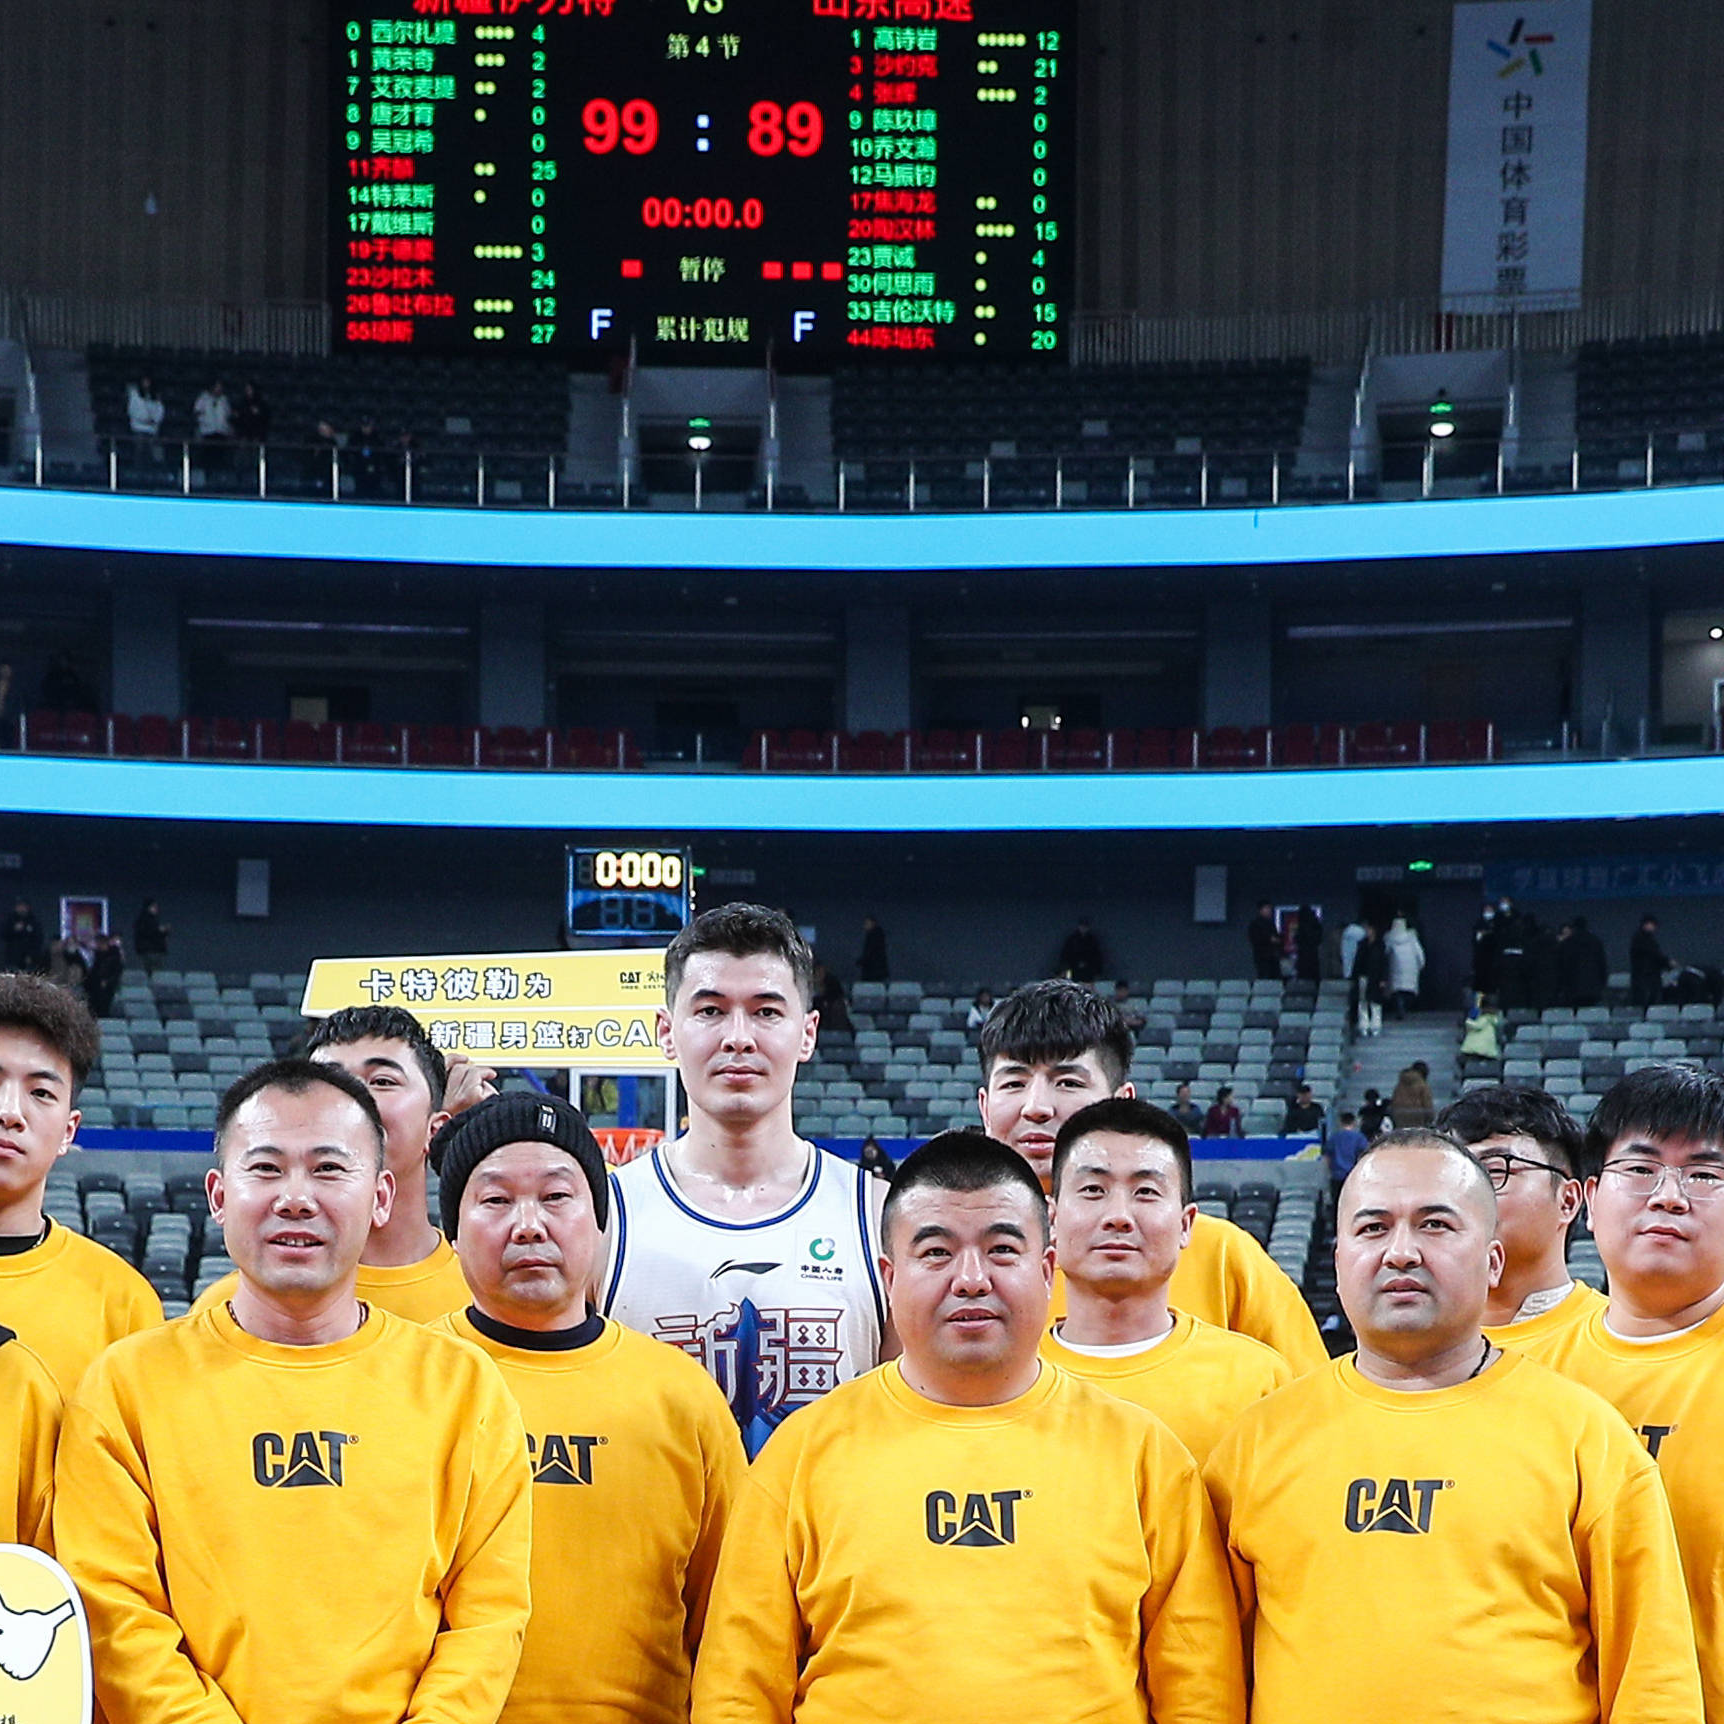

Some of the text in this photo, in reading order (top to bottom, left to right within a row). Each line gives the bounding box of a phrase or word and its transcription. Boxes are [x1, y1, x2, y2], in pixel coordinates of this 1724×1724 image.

[347, 21, 360, 41] 0
[532, 24, 545, 43] 4
[852, 29, 861, 48] 1
[1037, 31, 1059, 50] 12
[349, 50, 358, 68] 1
[532, 51, 545, 71] 2
[1035, 58, 1056, 77] 21
[347, 76, 360, 95] 7
[532, 79, 545, 98] 2
[1034, 86, 1047, 105] 2
[532, 106, 545, 125] 0
[849, 110, 862, 130] 9
[1034, 113, 1047, 132] 0
[581, 98, 659, 154] 99
[747, 100, 824, 157] 89
[346, 131, 360, 150] 9
[532, 133, 545, 152] 0
[851, 138, 873, 157] 10
[1033, 140, 1047, 159] 0
[349, 159, 370, 177] 11
[532, 161, 557, 180] 25
[850, 165, 873, 184] 12
[1033, 168, 1046, 186] 0
[349, 186, 370, 205] 14
[532, 188, 545, 207] 0
[851, 192, 873, 210] 17
[1033, 195, 1046, 214] 0
[1496, 90, 1533, 295] 中国体育彩票
[642, 197, 764, 228] 00:00.0
[349, 213, 370, 232] 17
[532, 215, 545, 234] 0
[849, 219, 873, 238] 20
[1035, 221, 1057, 241] 15
[532, 243, 545, 262] 3
[848, 247, 872, 266] 23
[1032, 250, 1045, 267] 4
[347, 267, 370, 286] 23
[532, 270, 555, 289] 24
[679, 256, 726, 282] 暂停
[848, 274, 872, 293] 30
[1032, 276, 1045, 295] 0
[533, 297, 556, 316] 12
[848, 301, 872, 320] 33
[1034, 303, 1057, 322] 15
[531, 324, 555, 343] 27
[591, 308, 613, 340] F
[656, 315, 750, 342] 累计犯规
[793, 310, 816, 342] F
[847, 329, 872, 346] 44
[1032, 331, 1057, 349] 20
[360, 968, 552, 1002] 卡特彼勒为
[619, 971, 641, 983] CAT
[429, 1019, 662, 1050] 新疆男篮打CA
[253, 1432, 348, 1487] CAT
[1345, 1478, 1446, 1534] CAT
[926, 1490, 1024, 1547] CAT
